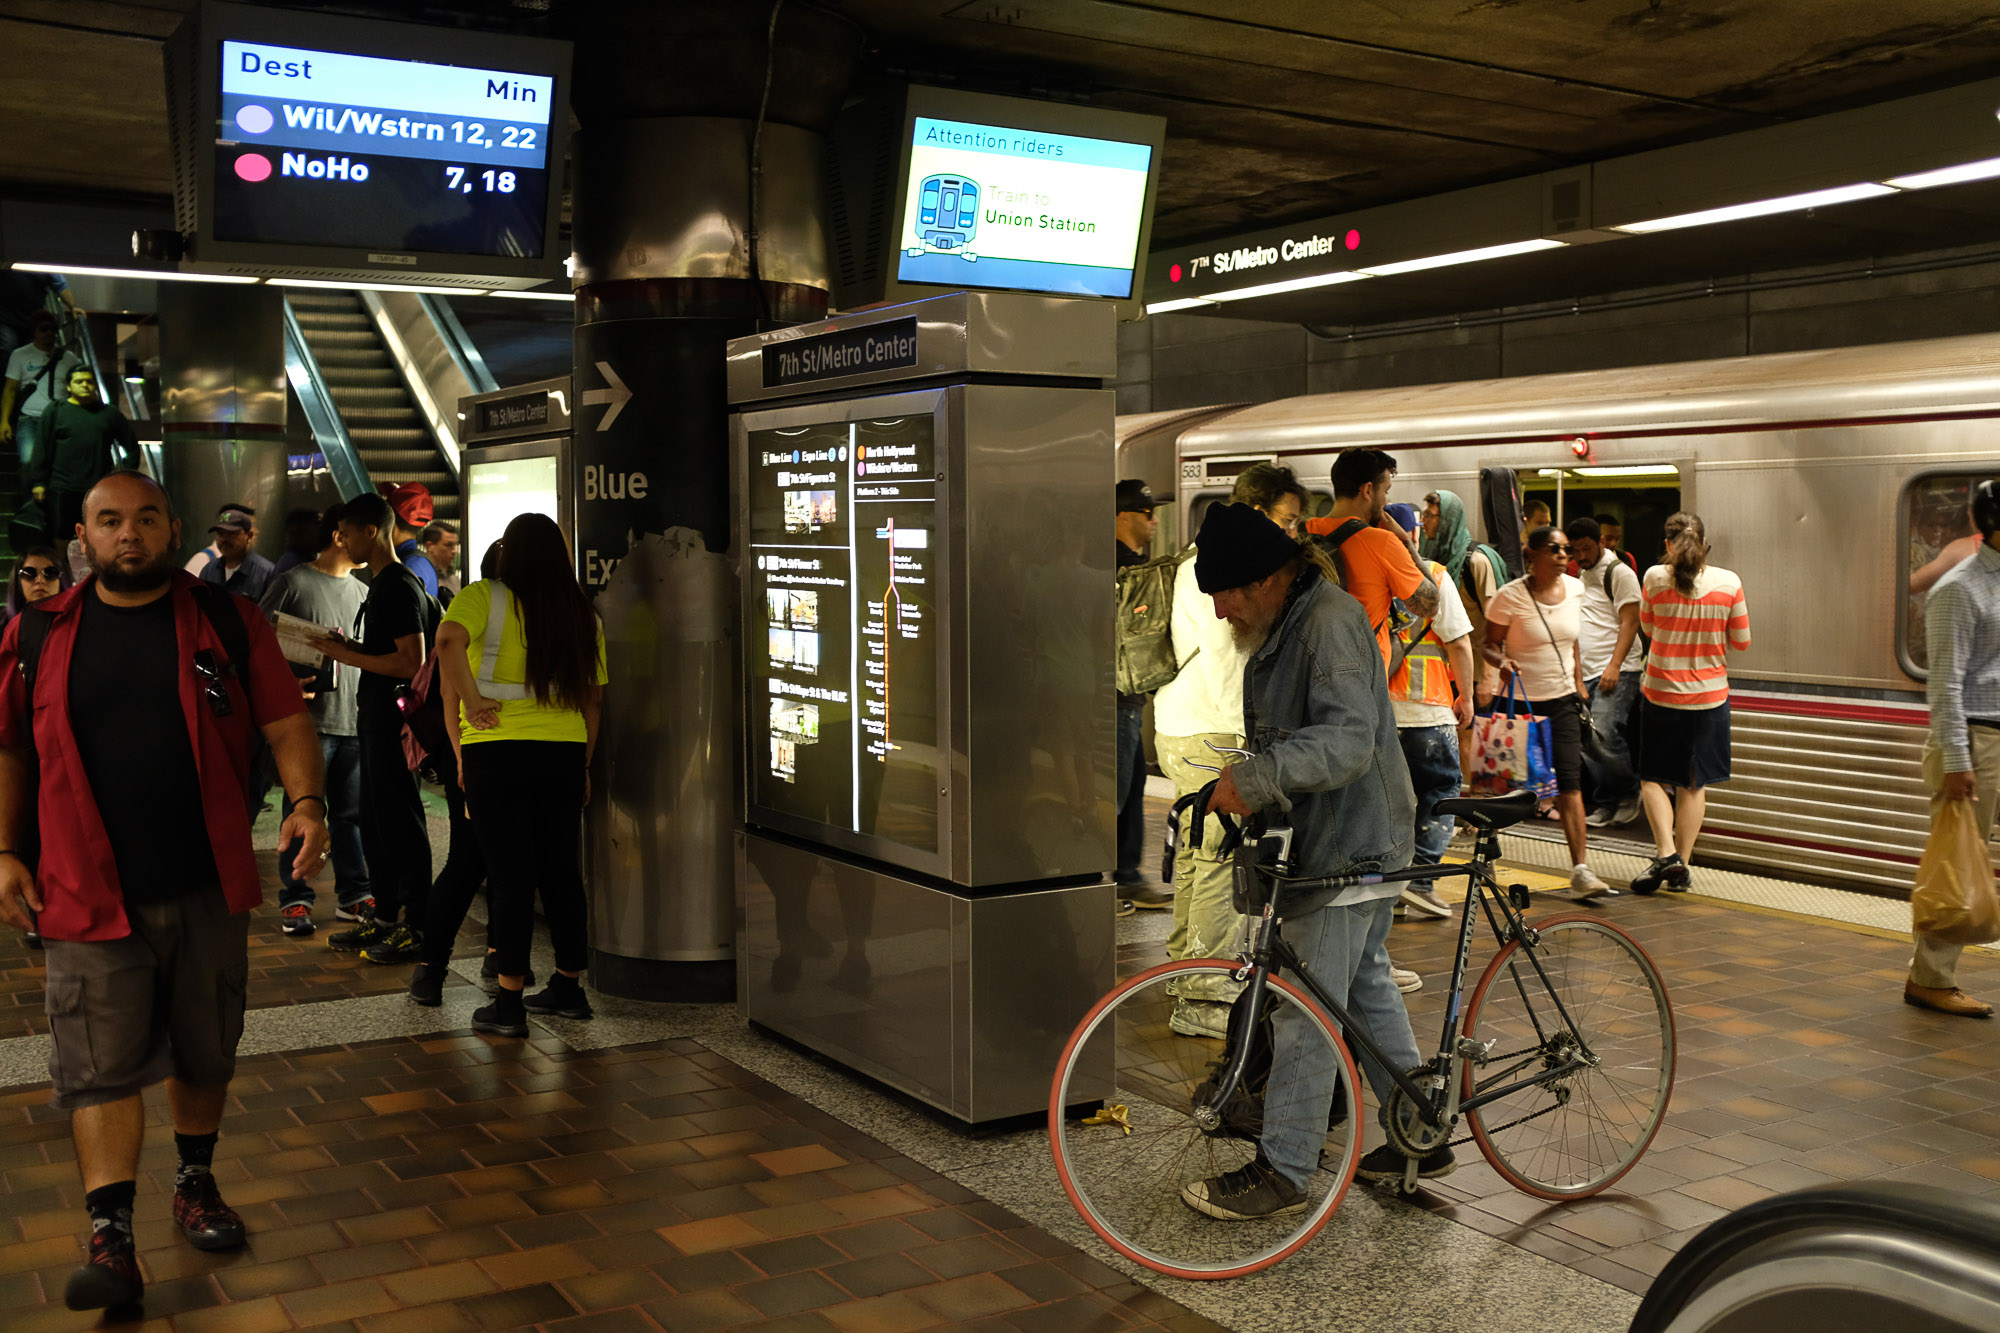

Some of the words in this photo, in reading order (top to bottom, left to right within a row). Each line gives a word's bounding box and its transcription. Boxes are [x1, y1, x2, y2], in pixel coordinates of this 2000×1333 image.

[240, 52, 312, 80] Dest
[486, 79, 536, 104] Min
[283, 104, 444, 142] Wil/Wstrn
[452, 121, 494, 149] 12,
[501, 127, 536, 150] 22
[926, 126, 1008, 151] Attention
[1013, 140, 1064, 157] riders
[282, 153, 368, 182] NoHo
[446, 167, 472, 194] 7,
[482, 170, 516, 194] 18
[988, 186, 1030, 204] Train
[1034, 193, 1050, 206] to
[986, 210, 1034, 228] Union
[1039, 214, 1096, 234] Station
[1213, 243, 1279, 274] St/Metro
[1282, 234, 1336, 260] Center
[779, 353, 800, 377] 7th
[802, 342, 861, 374] St/Metro
[864, 332, 916, 362] Center
[489, 410, 499, 426] 7th
[500, 406, 526, 424] St/Metro
[526, 404, 547, 420] Center
[585, 465, 648, 500] Blue
[1183, 465, 1201, 478] 583
[586, 550, 622, 584] Ex
